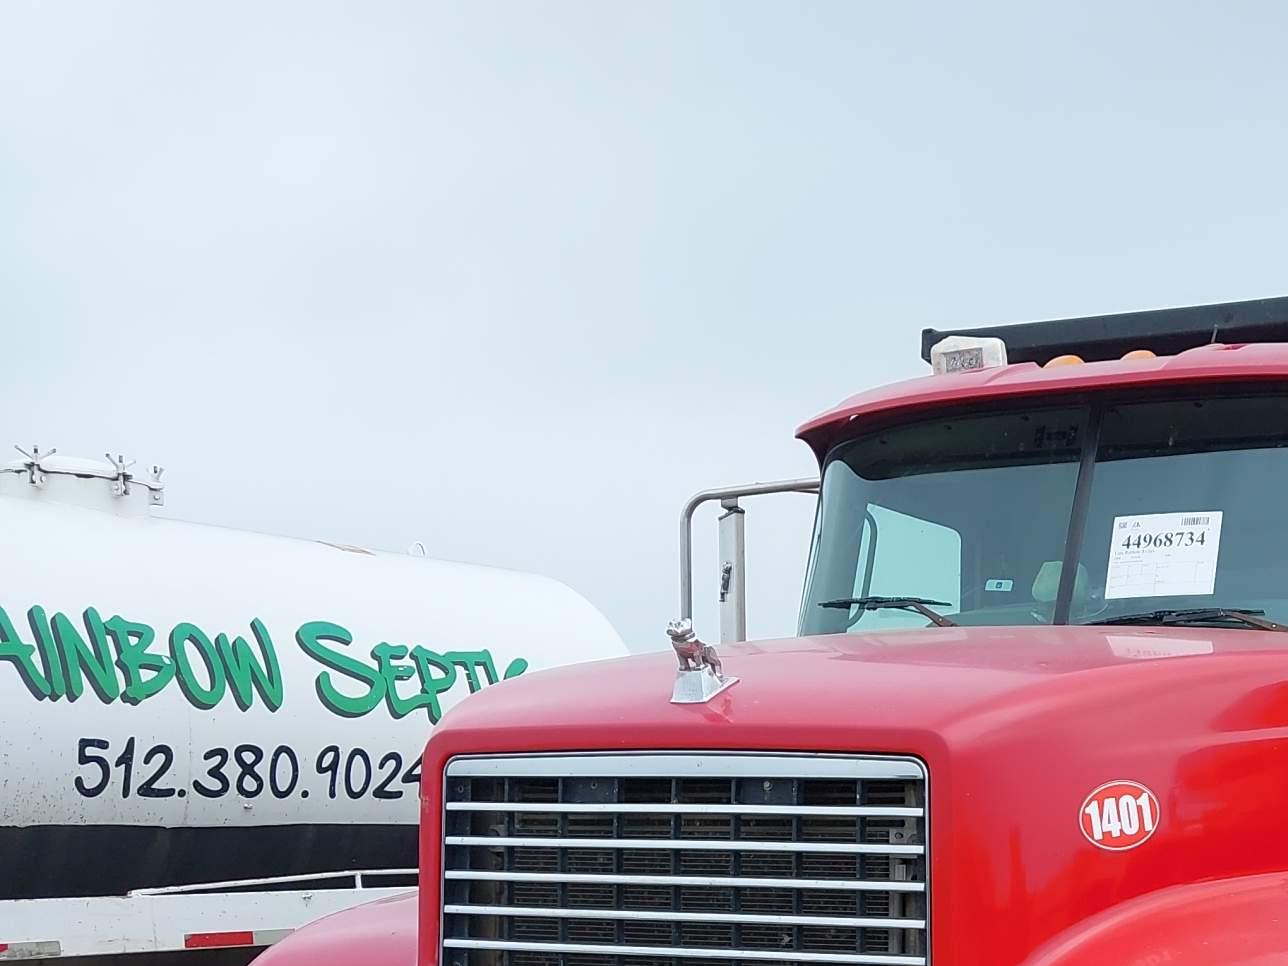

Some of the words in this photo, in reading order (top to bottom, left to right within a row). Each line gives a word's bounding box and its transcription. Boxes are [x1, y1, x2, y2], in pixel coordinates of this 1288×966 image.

[1121, 531, 1206, 549] 44968734
[295, 621, 528, 725] SEPT
[1084, 792, 1153, 841] 1401
